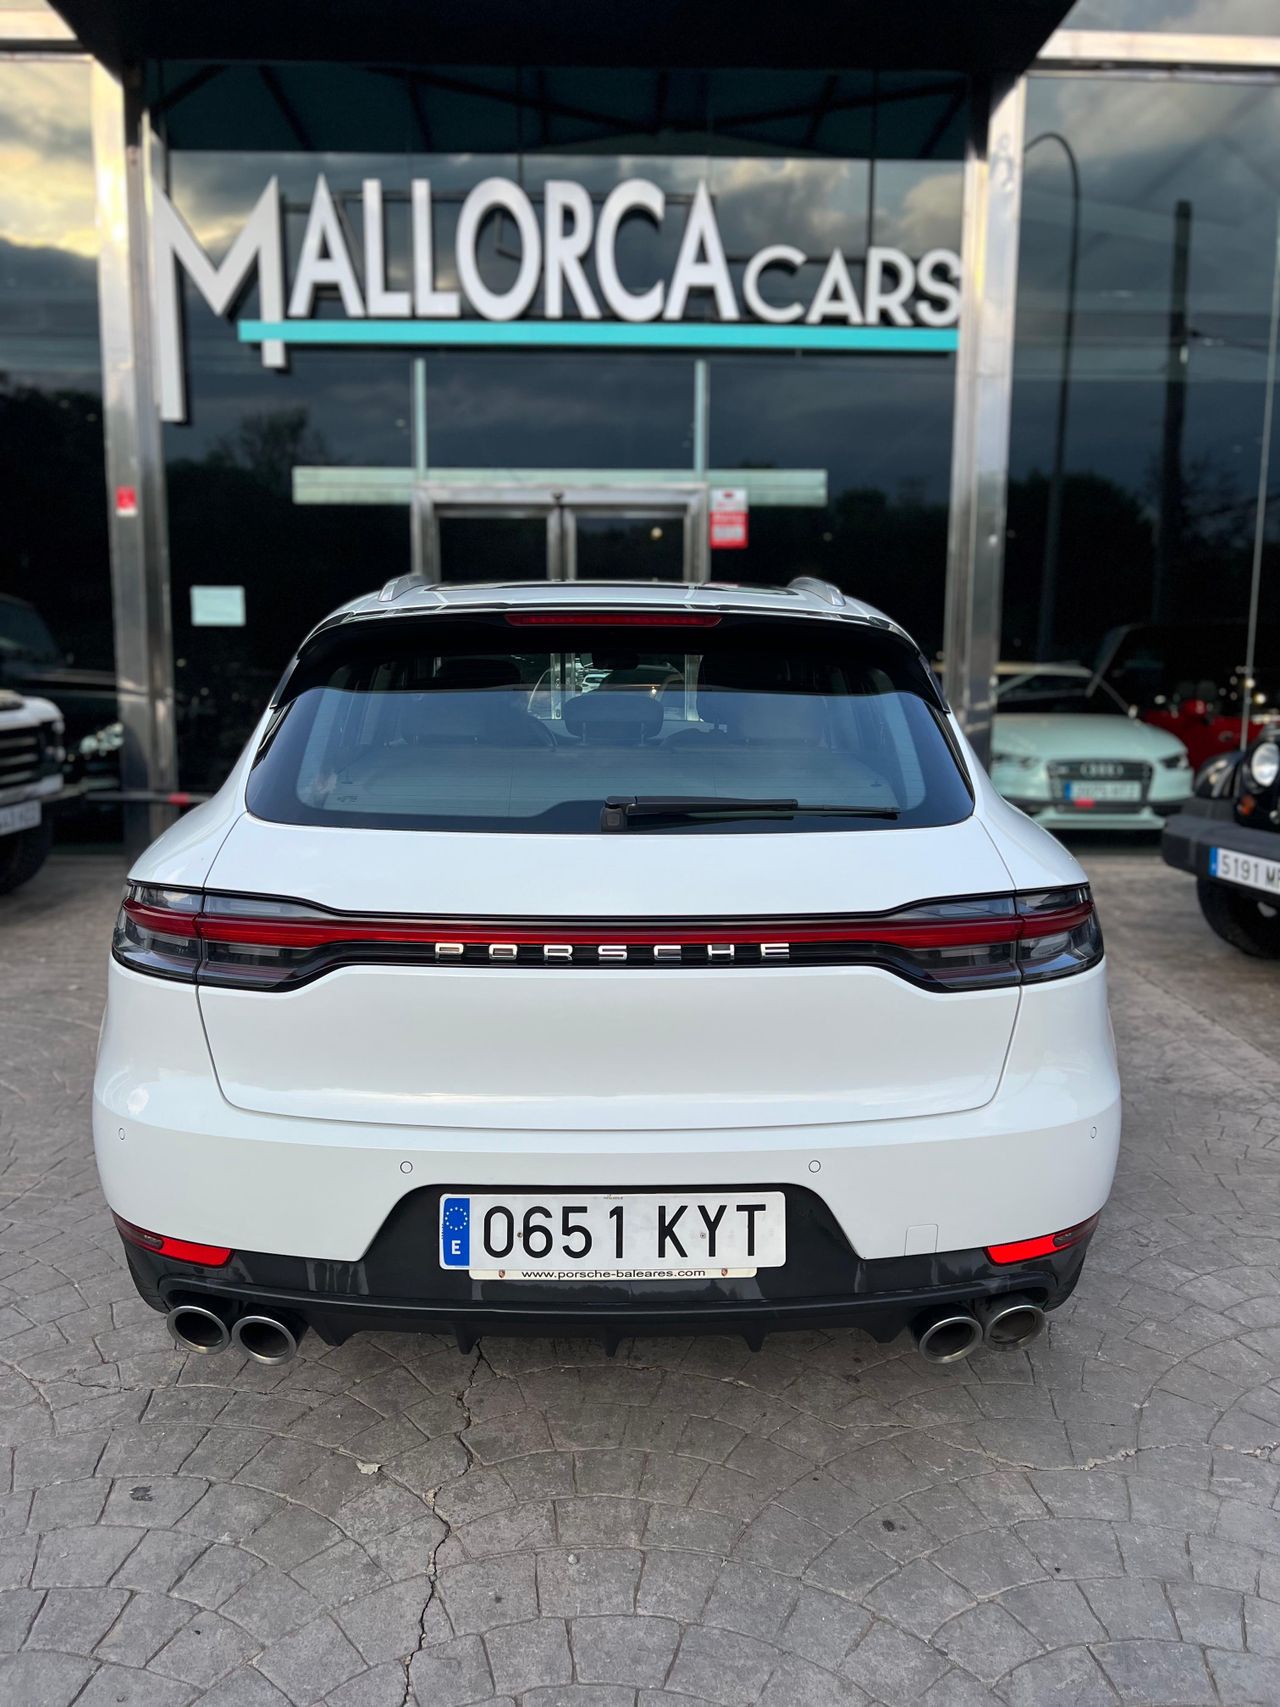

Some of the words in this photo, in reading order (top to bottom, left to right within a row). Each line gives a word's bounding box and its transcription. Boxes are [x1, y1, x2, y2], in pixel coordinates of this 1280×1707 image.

[150, 174, 741, 422] MALLORCA
[743, 244, 963, 327] CARS
[1221, 853, 1259, 884] 5191
[435, 942, 790, 961] PORSCHE
[483, 1205, 624, 1259] 0651
[657, 1203, 767, 1258] KYT
[451, 1239, 461, 1255] E
[521, 1269, 706, 1280] www.porsche-baleares.com
